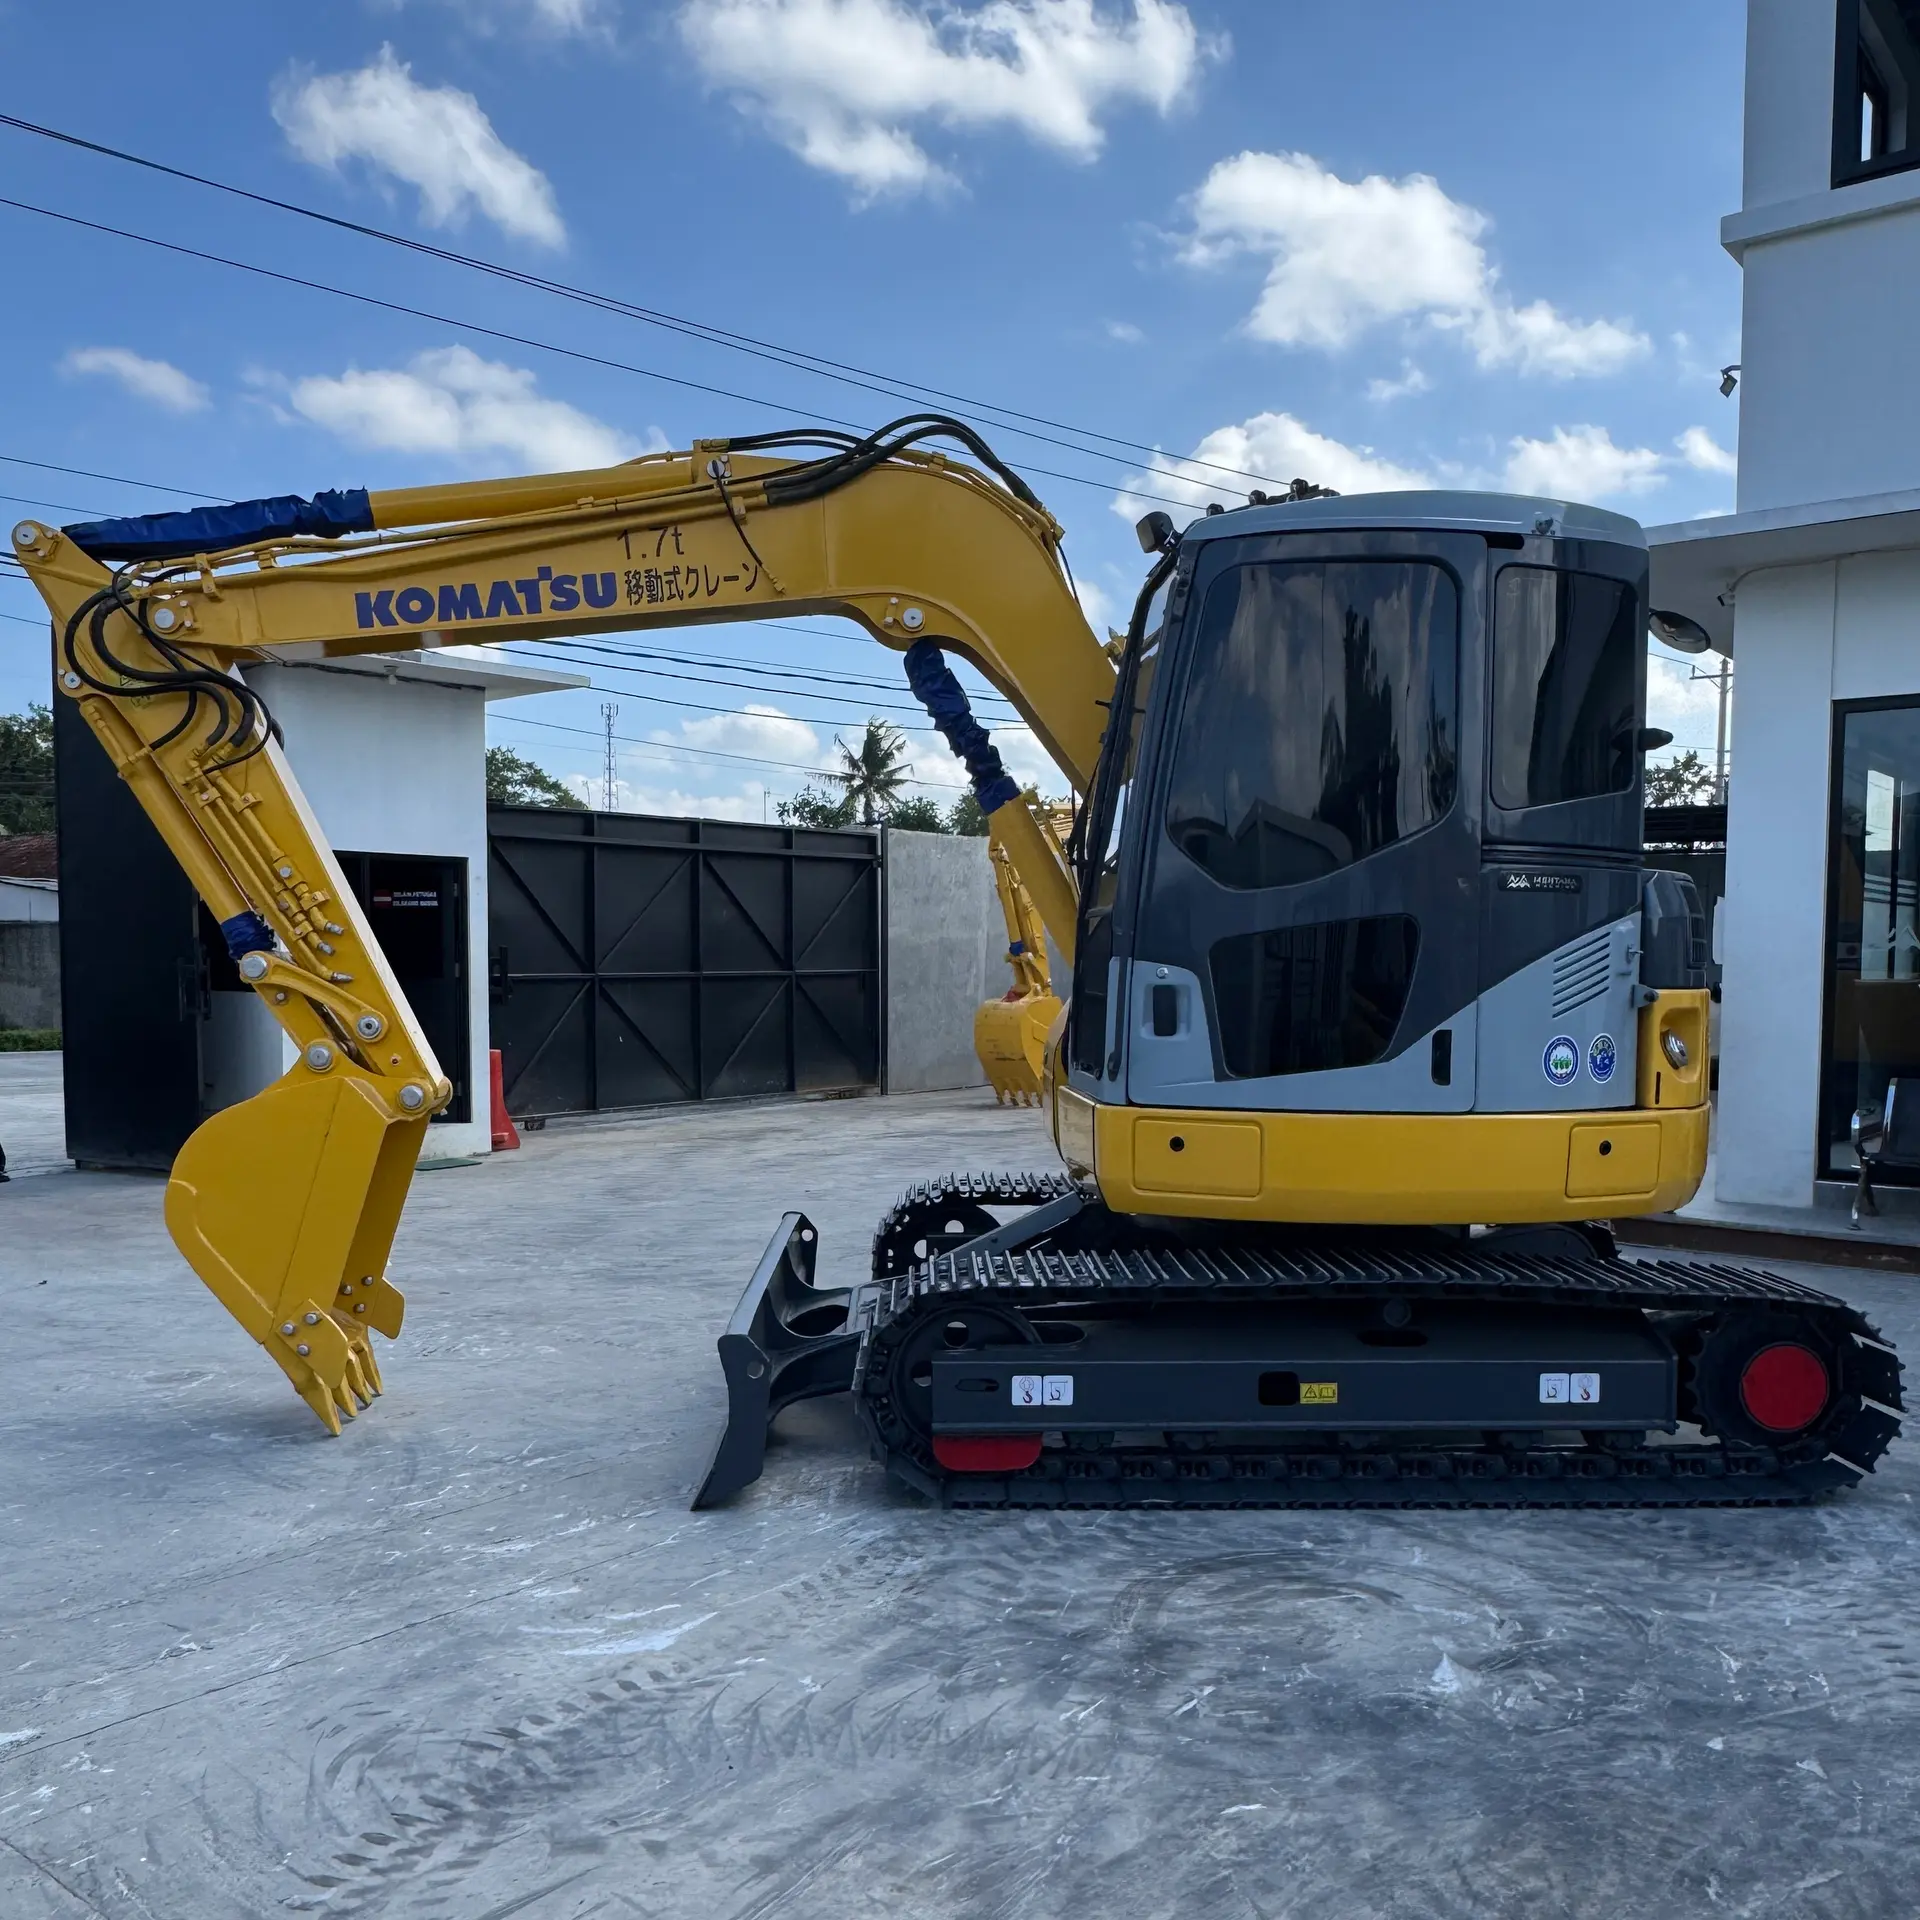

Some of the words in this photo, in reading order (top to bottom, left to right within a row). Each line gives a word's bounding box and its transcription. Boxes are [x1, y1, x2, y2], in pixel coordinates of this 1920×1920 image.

[617, 526, 684, 560] 1.7t
[355, 566, 617, 628] KOMATSU
[624, 563, 758, 606] 移動式クレーン
